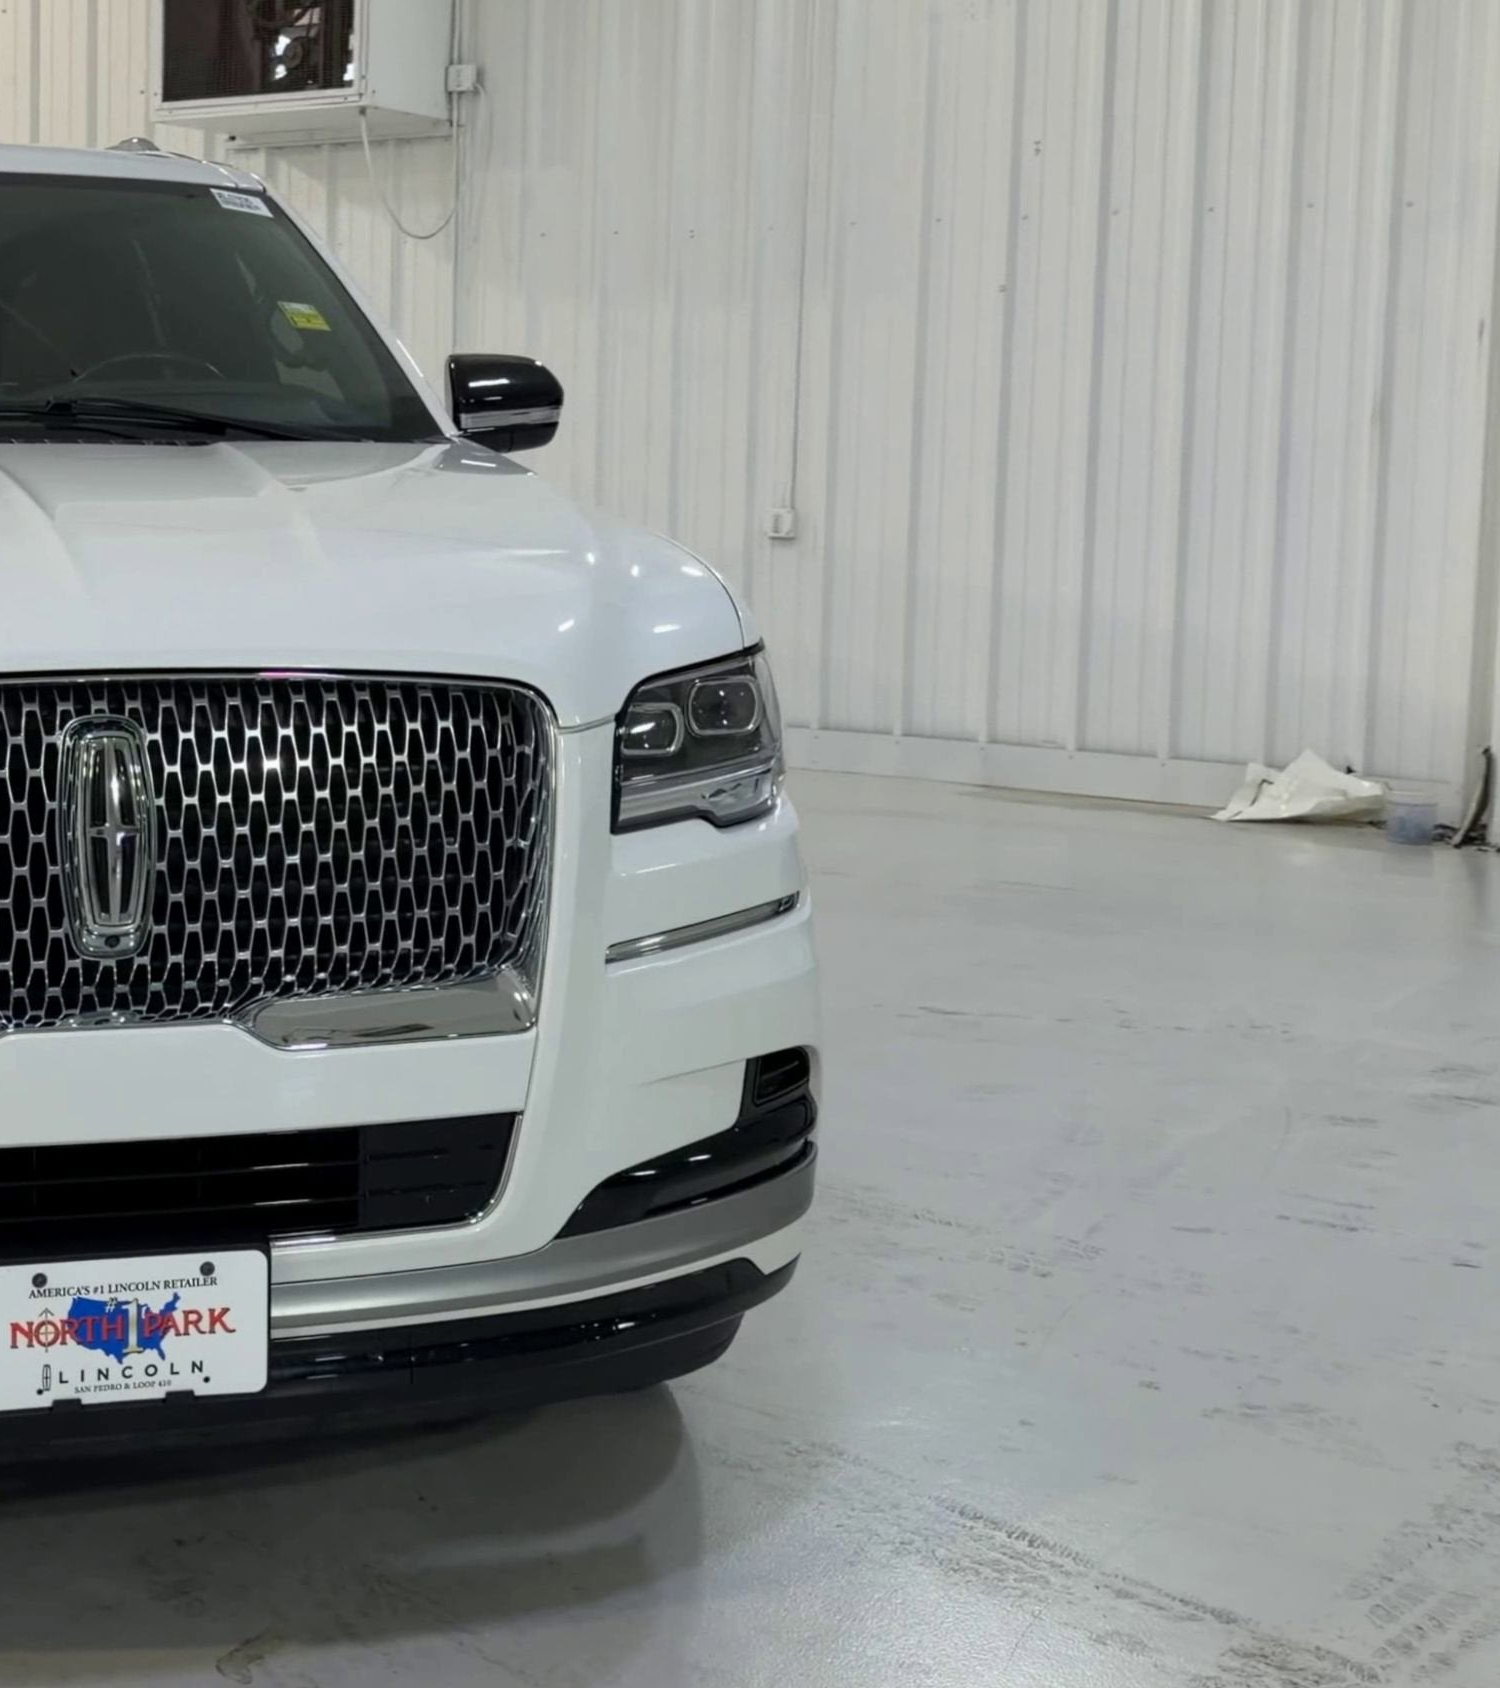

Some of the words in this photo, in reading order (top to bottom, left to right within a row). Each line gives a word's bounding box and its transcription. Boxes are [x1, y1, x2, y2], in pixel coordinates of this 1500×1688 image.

[29, 1284, 90, 1299] AMERICA'S
[93, 1284, 105, 1295] #1
[108, 1280, 161, 1293] LINCOLN
[163, 1276, 218, 1290] RETAILER
[9, 1314, 124, 1349] NORTH
[143, 1307, 236, 1340] PARK
[59, 1360, 204, 1384] LINCOLN
[74, 1385, 92, 1394] SAN
[93, 1383, 122, 1393] PEDRO
